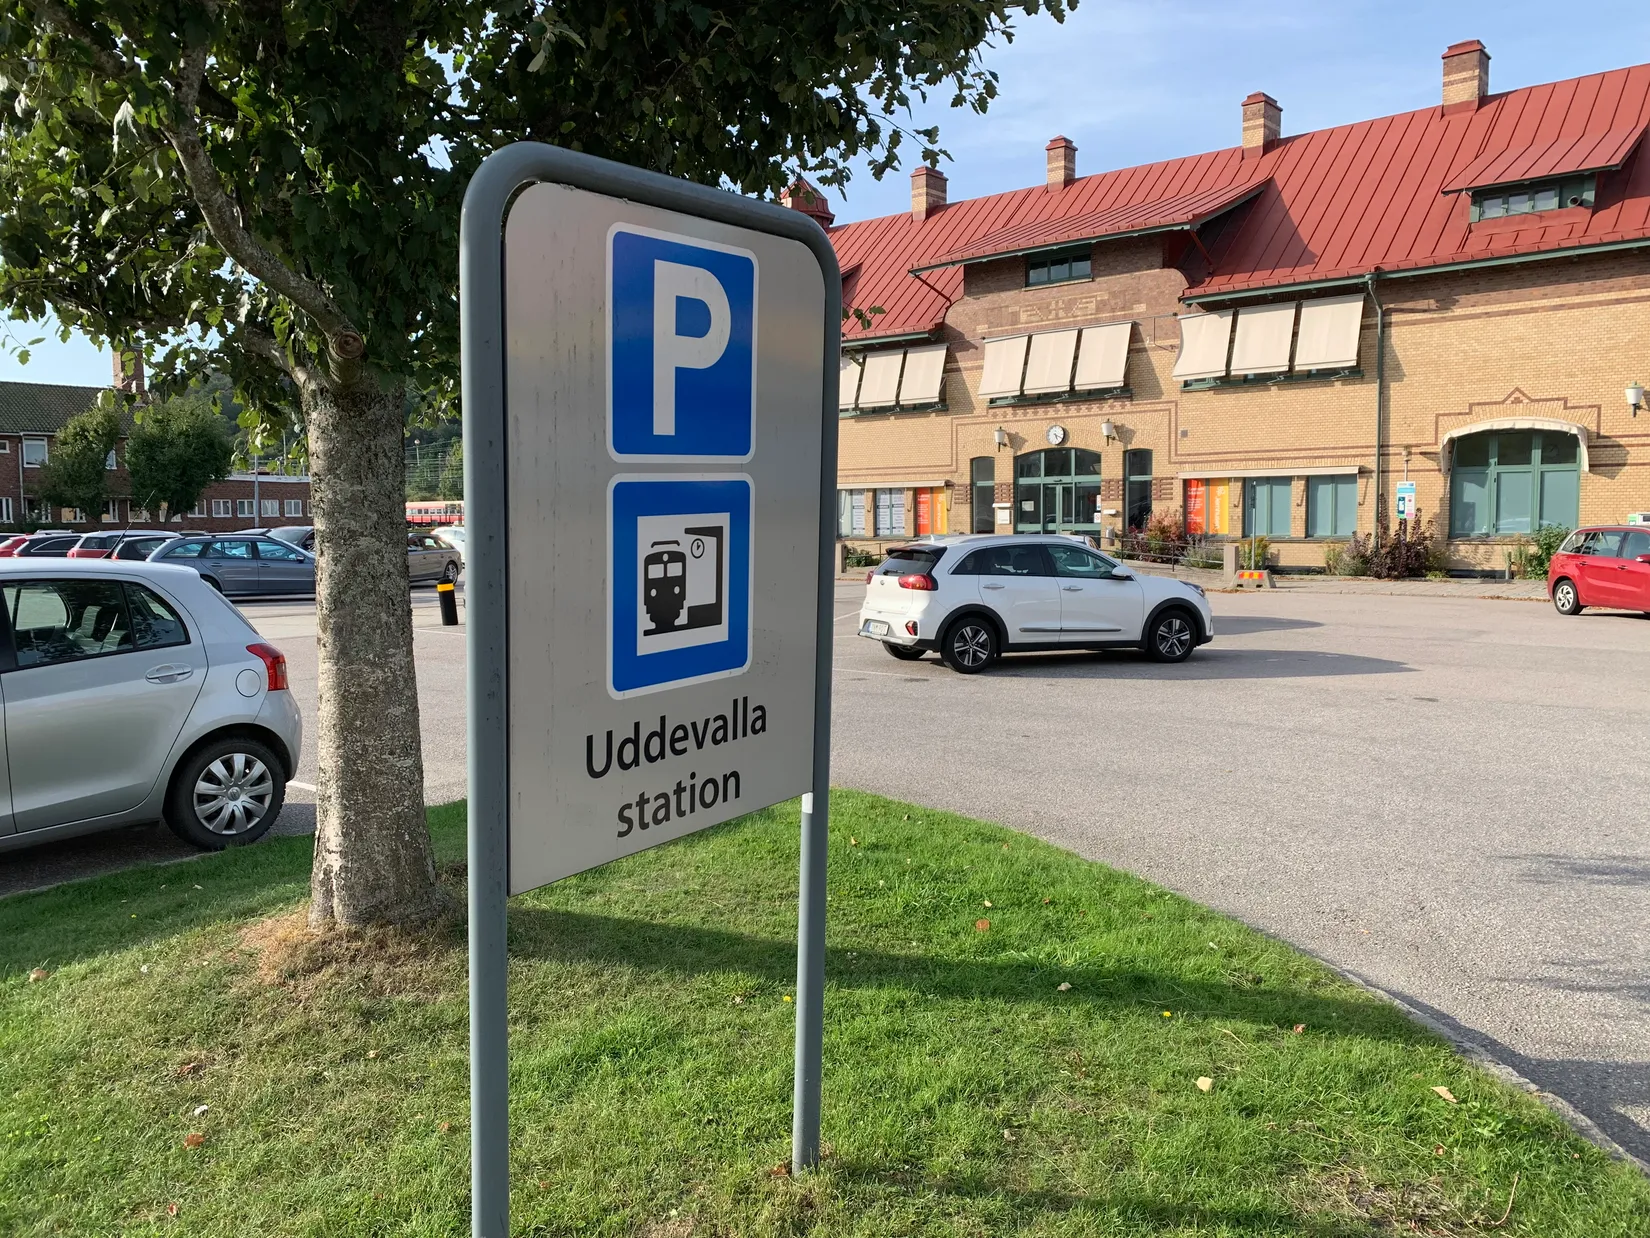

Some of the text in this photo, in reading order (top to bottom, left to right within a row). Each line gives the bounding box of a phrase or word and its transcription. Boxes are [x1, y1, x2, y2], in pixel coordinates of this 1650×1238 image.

[653, 259, 732, 436] P
[586, 696, 767, 779] Uddevalla
[617, 770, 741, 838] station
